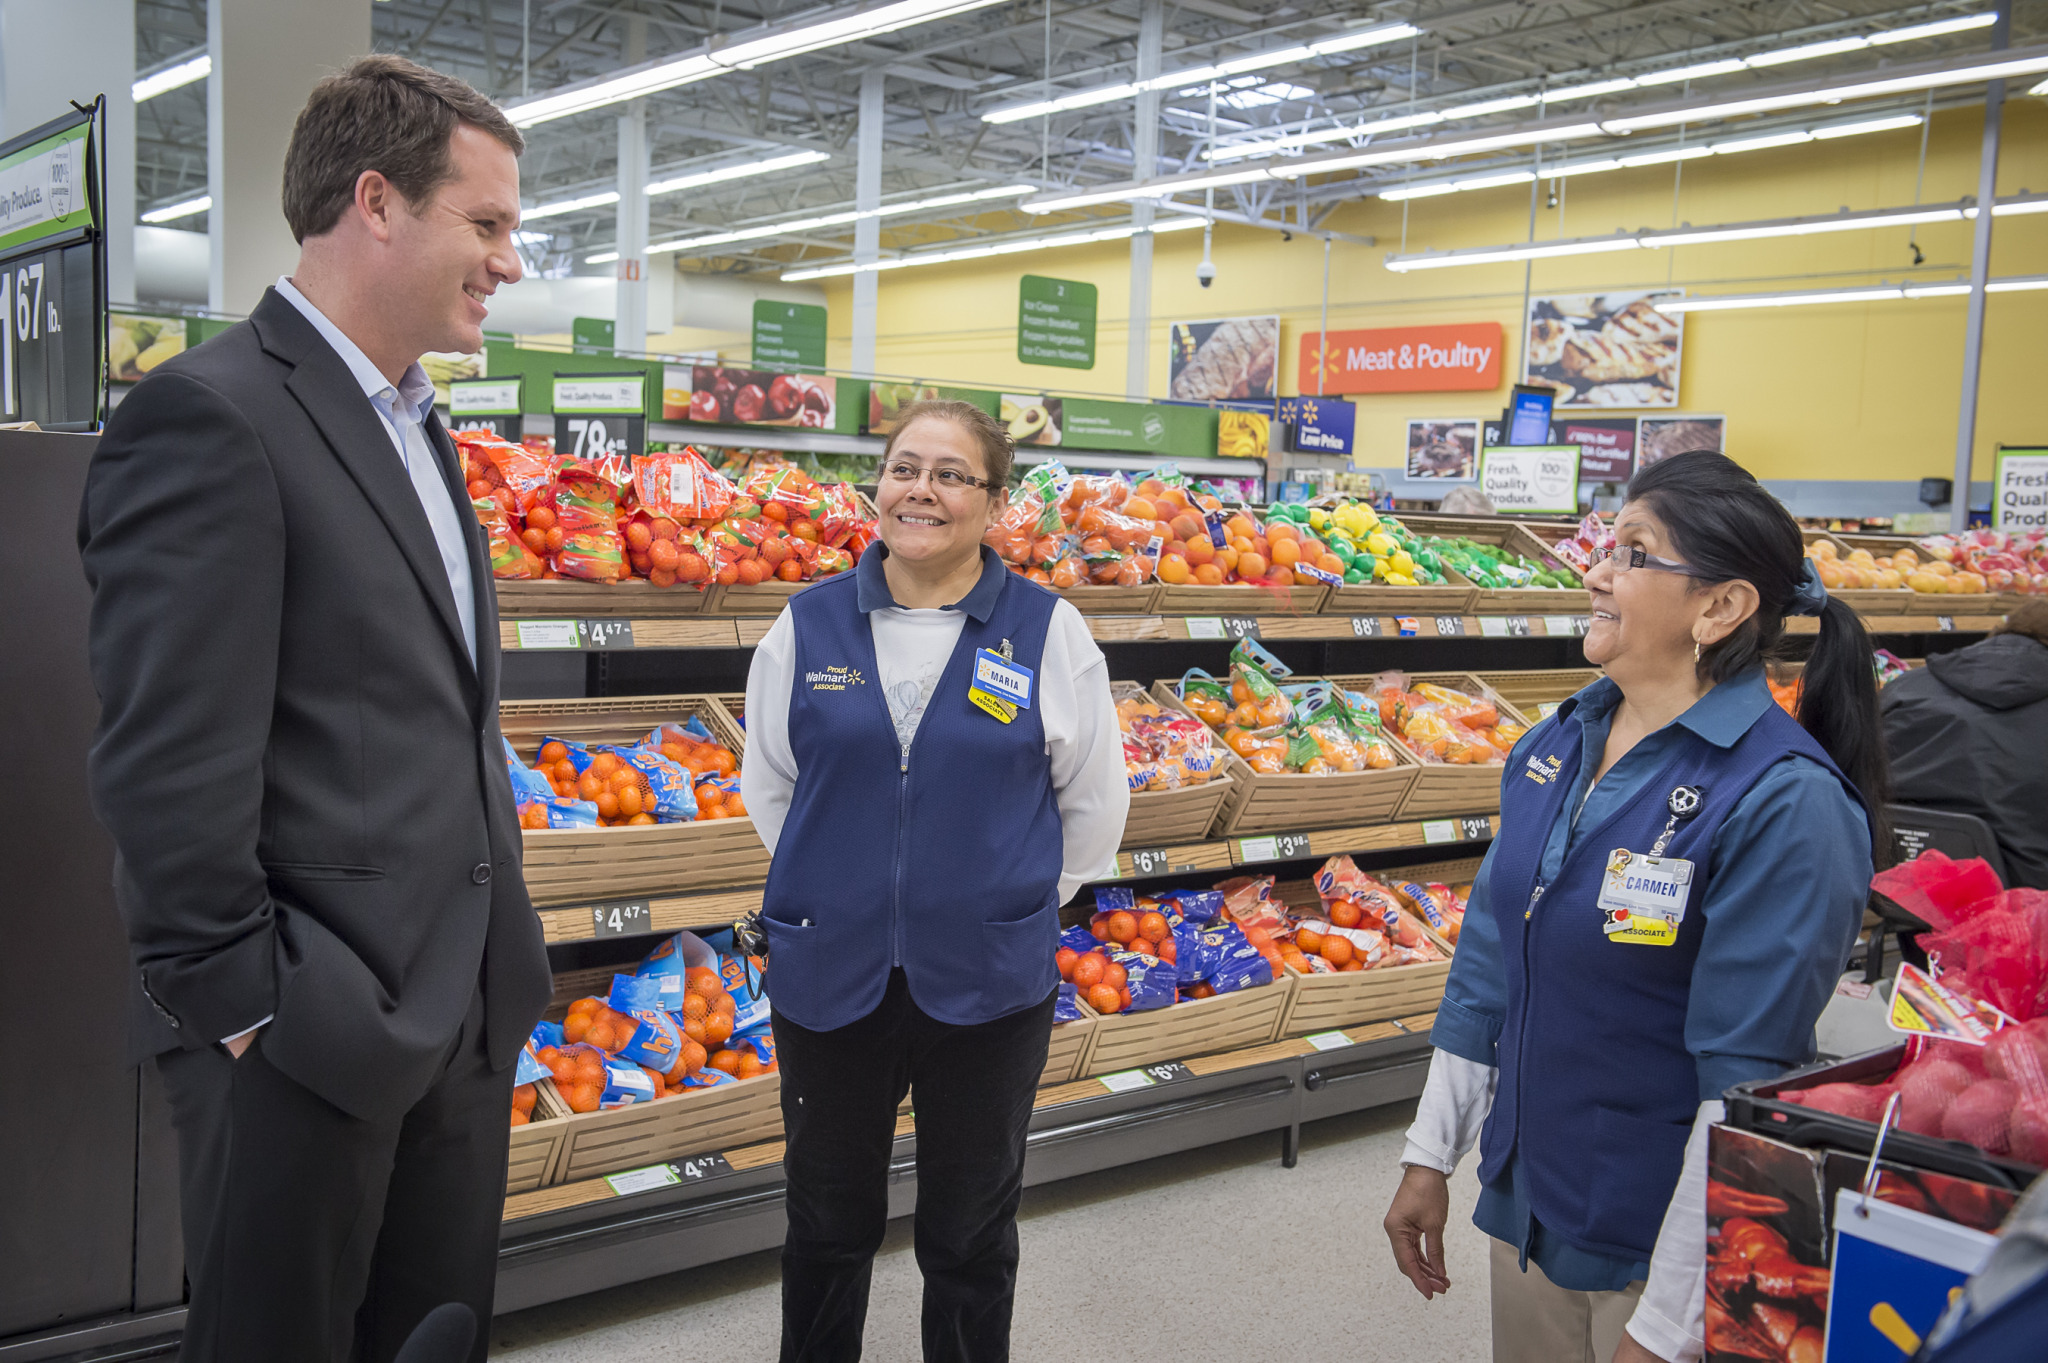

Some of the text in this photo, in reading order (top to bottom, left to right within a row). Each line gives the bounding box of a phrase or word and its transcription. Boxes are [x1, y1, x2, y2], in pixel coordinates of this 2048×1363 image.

[12, 184, 43, 213] Produce.
[1034, 301, 1060, 313] Cream
[47, 301, 61, 333] lb.
[1346, 340, 1492, 374] Meat & Poultry
[1300, 432, 1345, 450] Low Price
[1597, 432, 1617, 446] Beef
[1596, 447, 1631, 461] Certified
[1486, 478, 1528, 492] Quality
[1487, 492, 1538, 505] Produce.
[805, 671, 848, 683] Walmart
[827, 665, 848, 674] Proud
[813, 683, 846, 691] Associate
[990, 670, 1019, 691] MARIA
[976, 697, 1004, 717] ASSOCIATE
[1526, 754, 1556, 779] Walmart
[1626, 876, 1678, 898] CARMEN
[1403, 882, 1443, 928] ORANGES
[1622, 928, 1667, 938] ASSOCIATE
